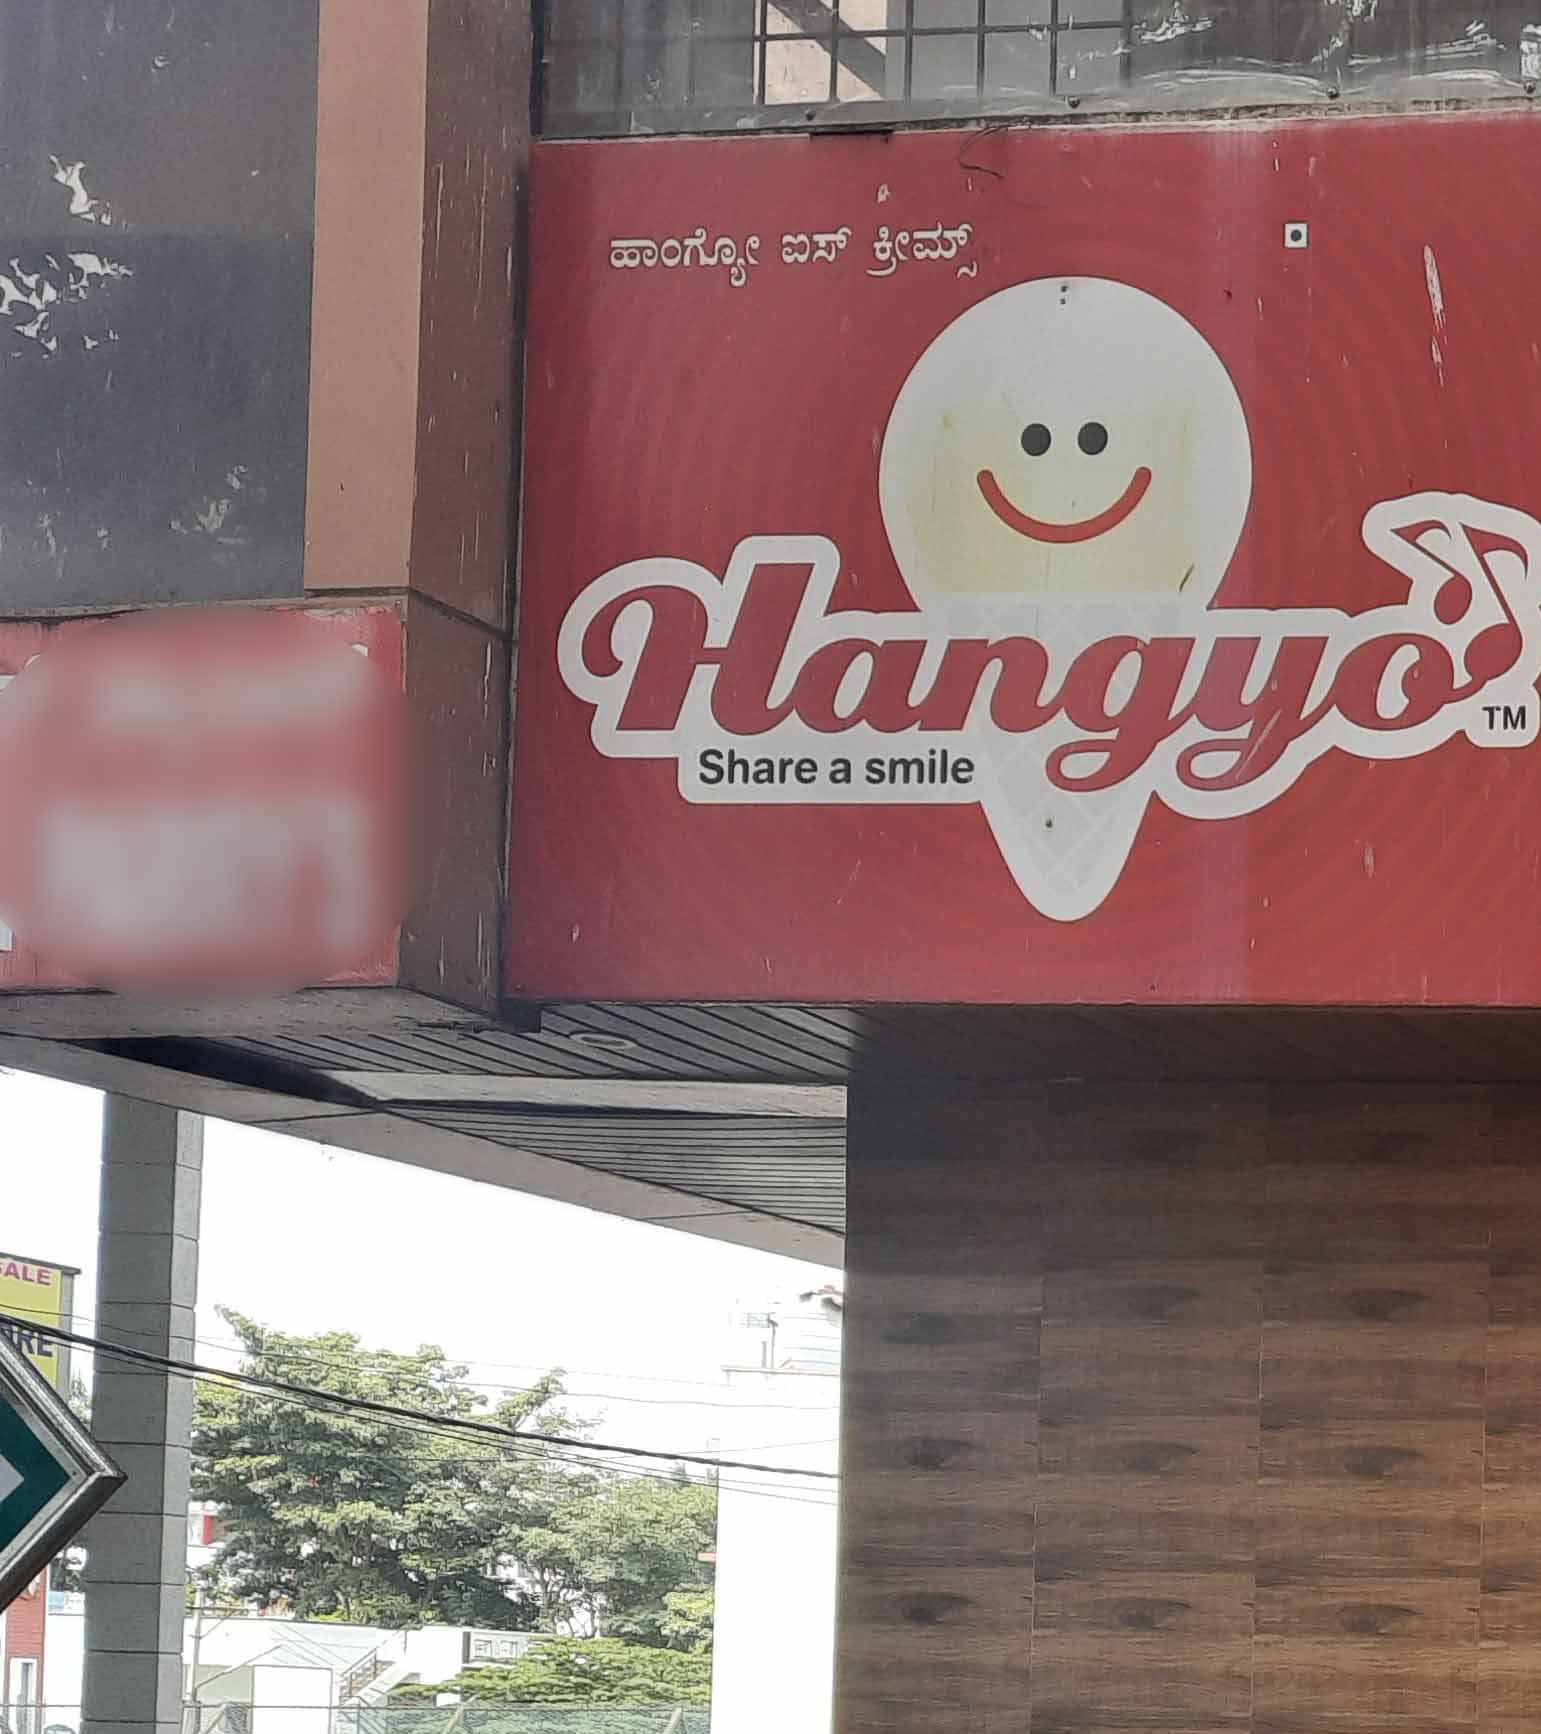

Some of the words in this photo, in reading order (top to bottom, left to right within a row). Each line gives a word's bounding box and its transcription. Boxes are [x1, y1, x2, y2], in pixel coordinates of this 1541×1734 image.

[781, 225, 853, 264] ಐಸ್
[698, 747, 821, 787] Share
[829, 756, 854, 786] a
[864, 747, 975, 786] smile
[0, 1261, 52, 1286] ALE
